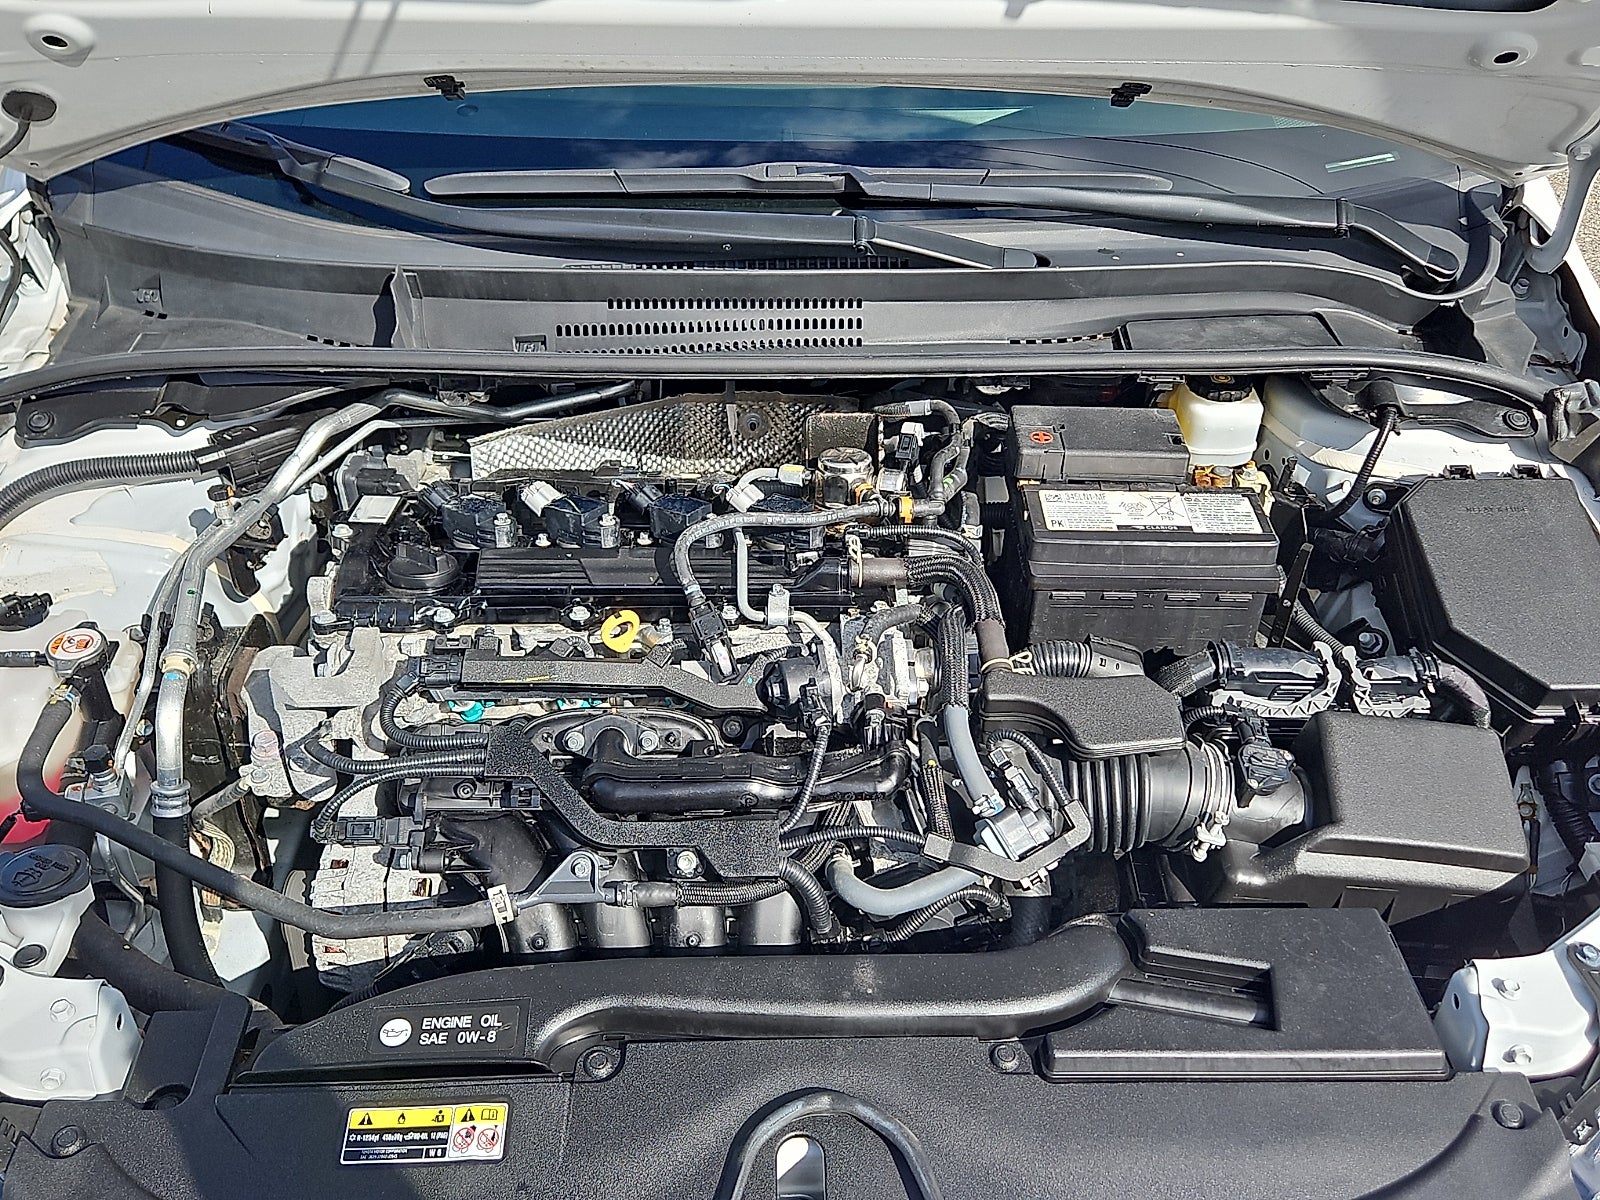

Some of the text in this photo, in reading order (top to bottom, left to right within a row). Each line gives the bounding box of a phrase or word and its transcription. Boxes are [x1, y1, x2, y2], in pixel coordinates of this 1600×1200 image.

[1051, 519, 1065, 528] PK
[421, 1013, 502, 1029] ENGINE OIL
[419, 1030, 496, 1045] SAE 0W-8
